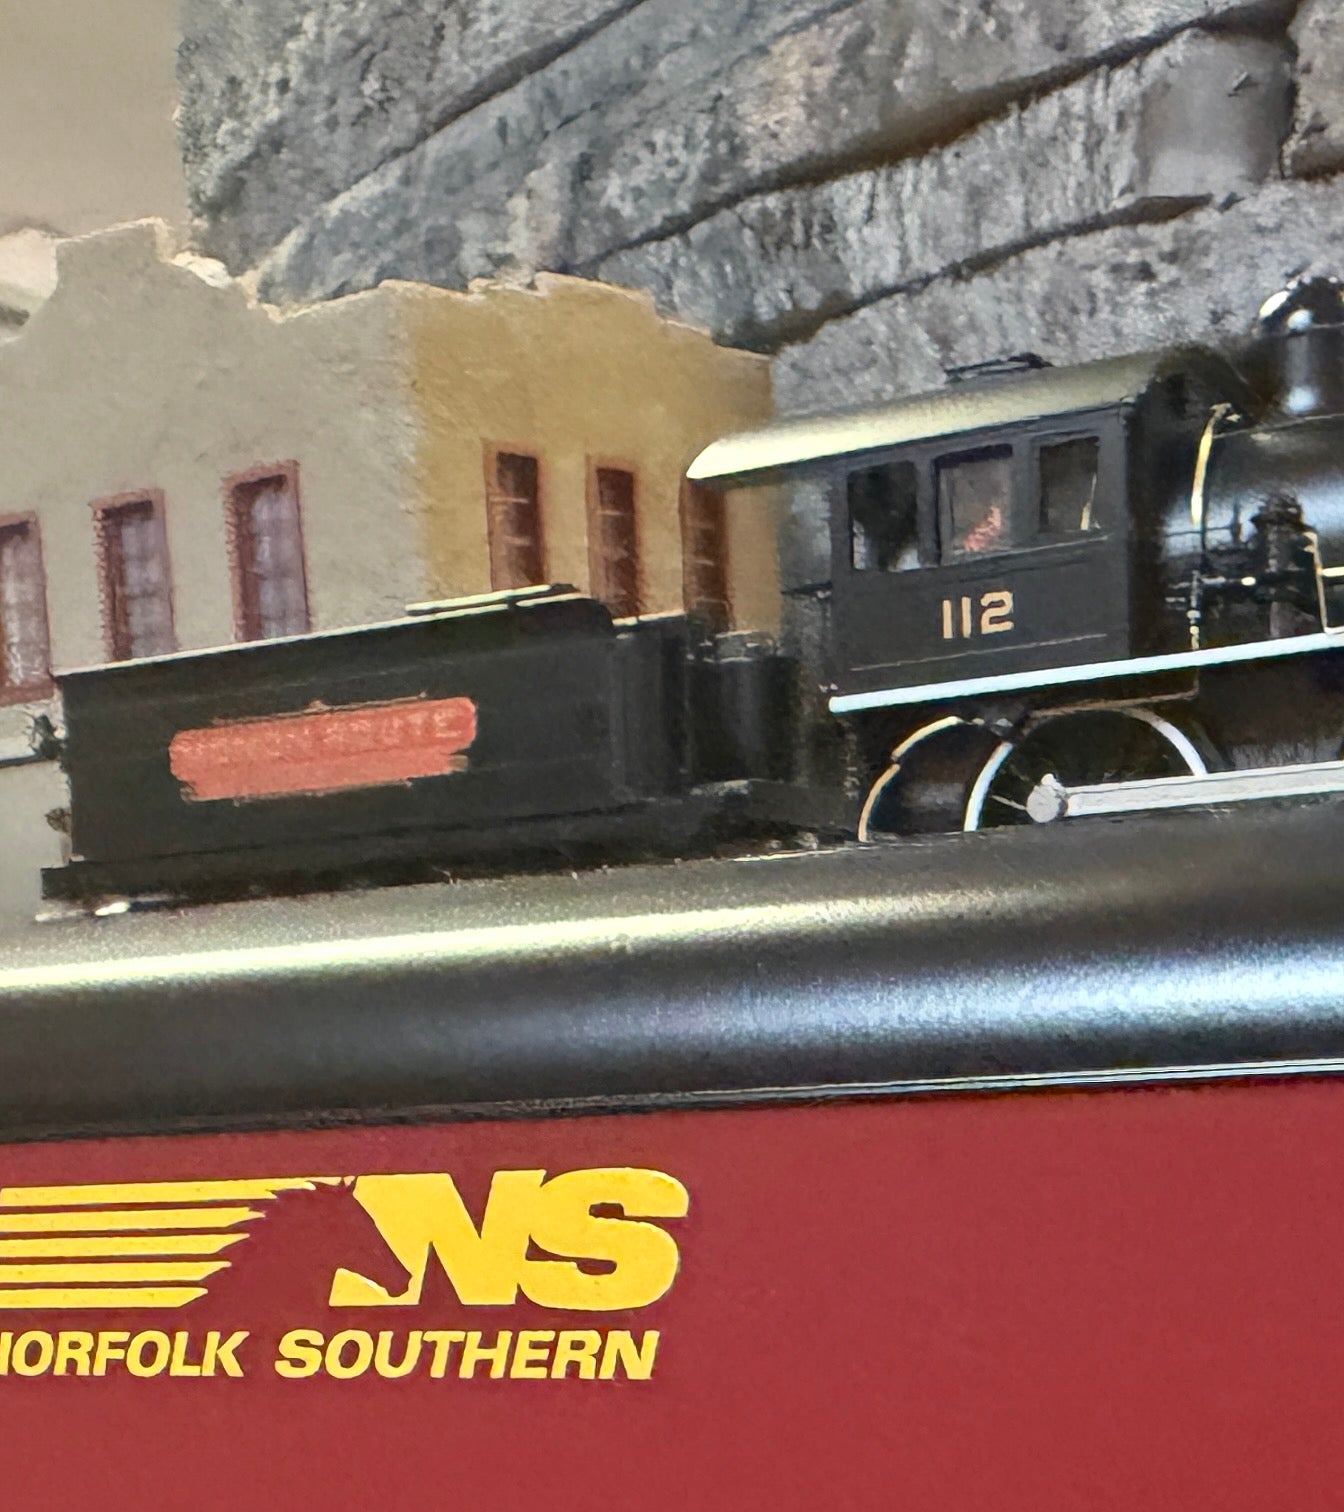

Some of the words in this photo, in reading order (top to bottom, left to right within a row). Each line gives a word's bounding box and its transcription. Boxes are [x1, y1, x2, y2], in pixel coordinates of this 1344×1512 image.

[942, 590, 1014, 639] 112
[329, 1167, 690, 1312] NS
[275, 1330, 660, 1380] SOUTHERN
